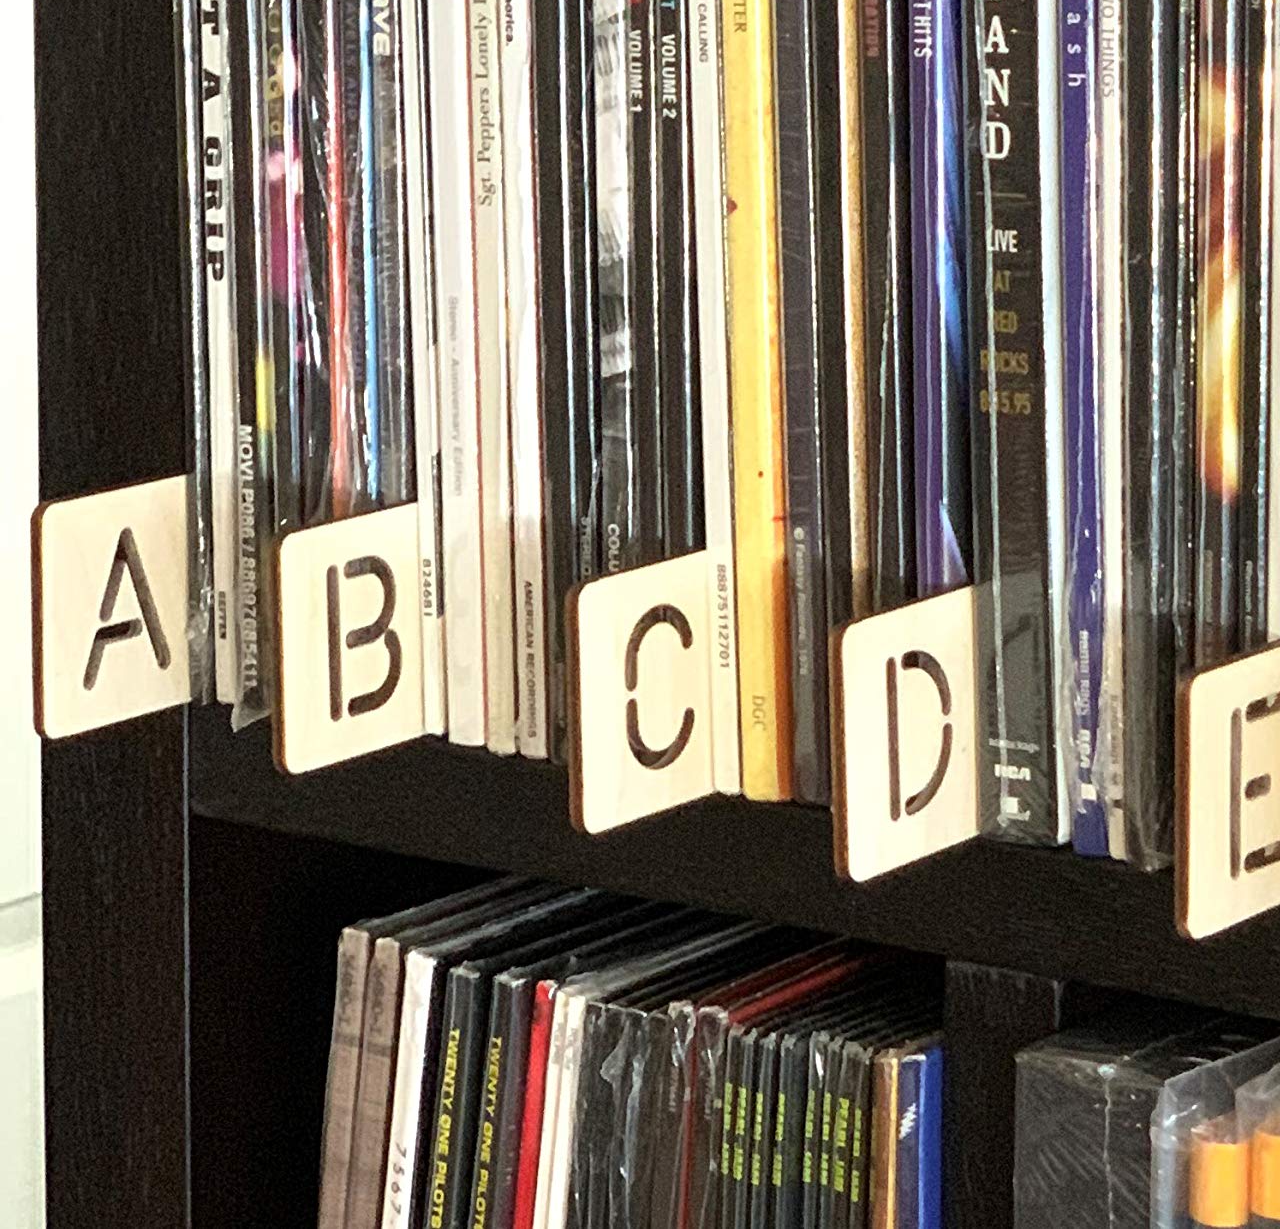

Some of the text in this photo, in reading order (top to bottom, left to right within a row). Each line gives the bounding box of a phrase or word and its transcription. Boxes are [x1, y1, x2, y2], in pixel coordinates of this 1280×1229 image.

[661, 34, 675, 102] VOLUME
[697, 4, 709, 62] CALLING
[913, 16, 933, 58] HITS
[1102, 28, 1116, 98] THINGS
[203, 68, 221, 101] A
[662, 108, 676, 118] 2
[204, 137, 224, 281] GRIP
[987, 229, 1018, 252] LIVE
[83, 526, 171, 691] A
[422, 559, 432, 617] 824681
[327, 556, 403, 721] B
[524, 581, 539, 738] AMERICAN RECORDINGS
[624, 604, 695, 770] C
[886, 651, 953, 821] D
[485, 1036, 502, 1117] TWENTY
[430, 1028, 460, 1228] TWENTY ONE PILOTS
[480, 1121, 494, 1163] ONE
